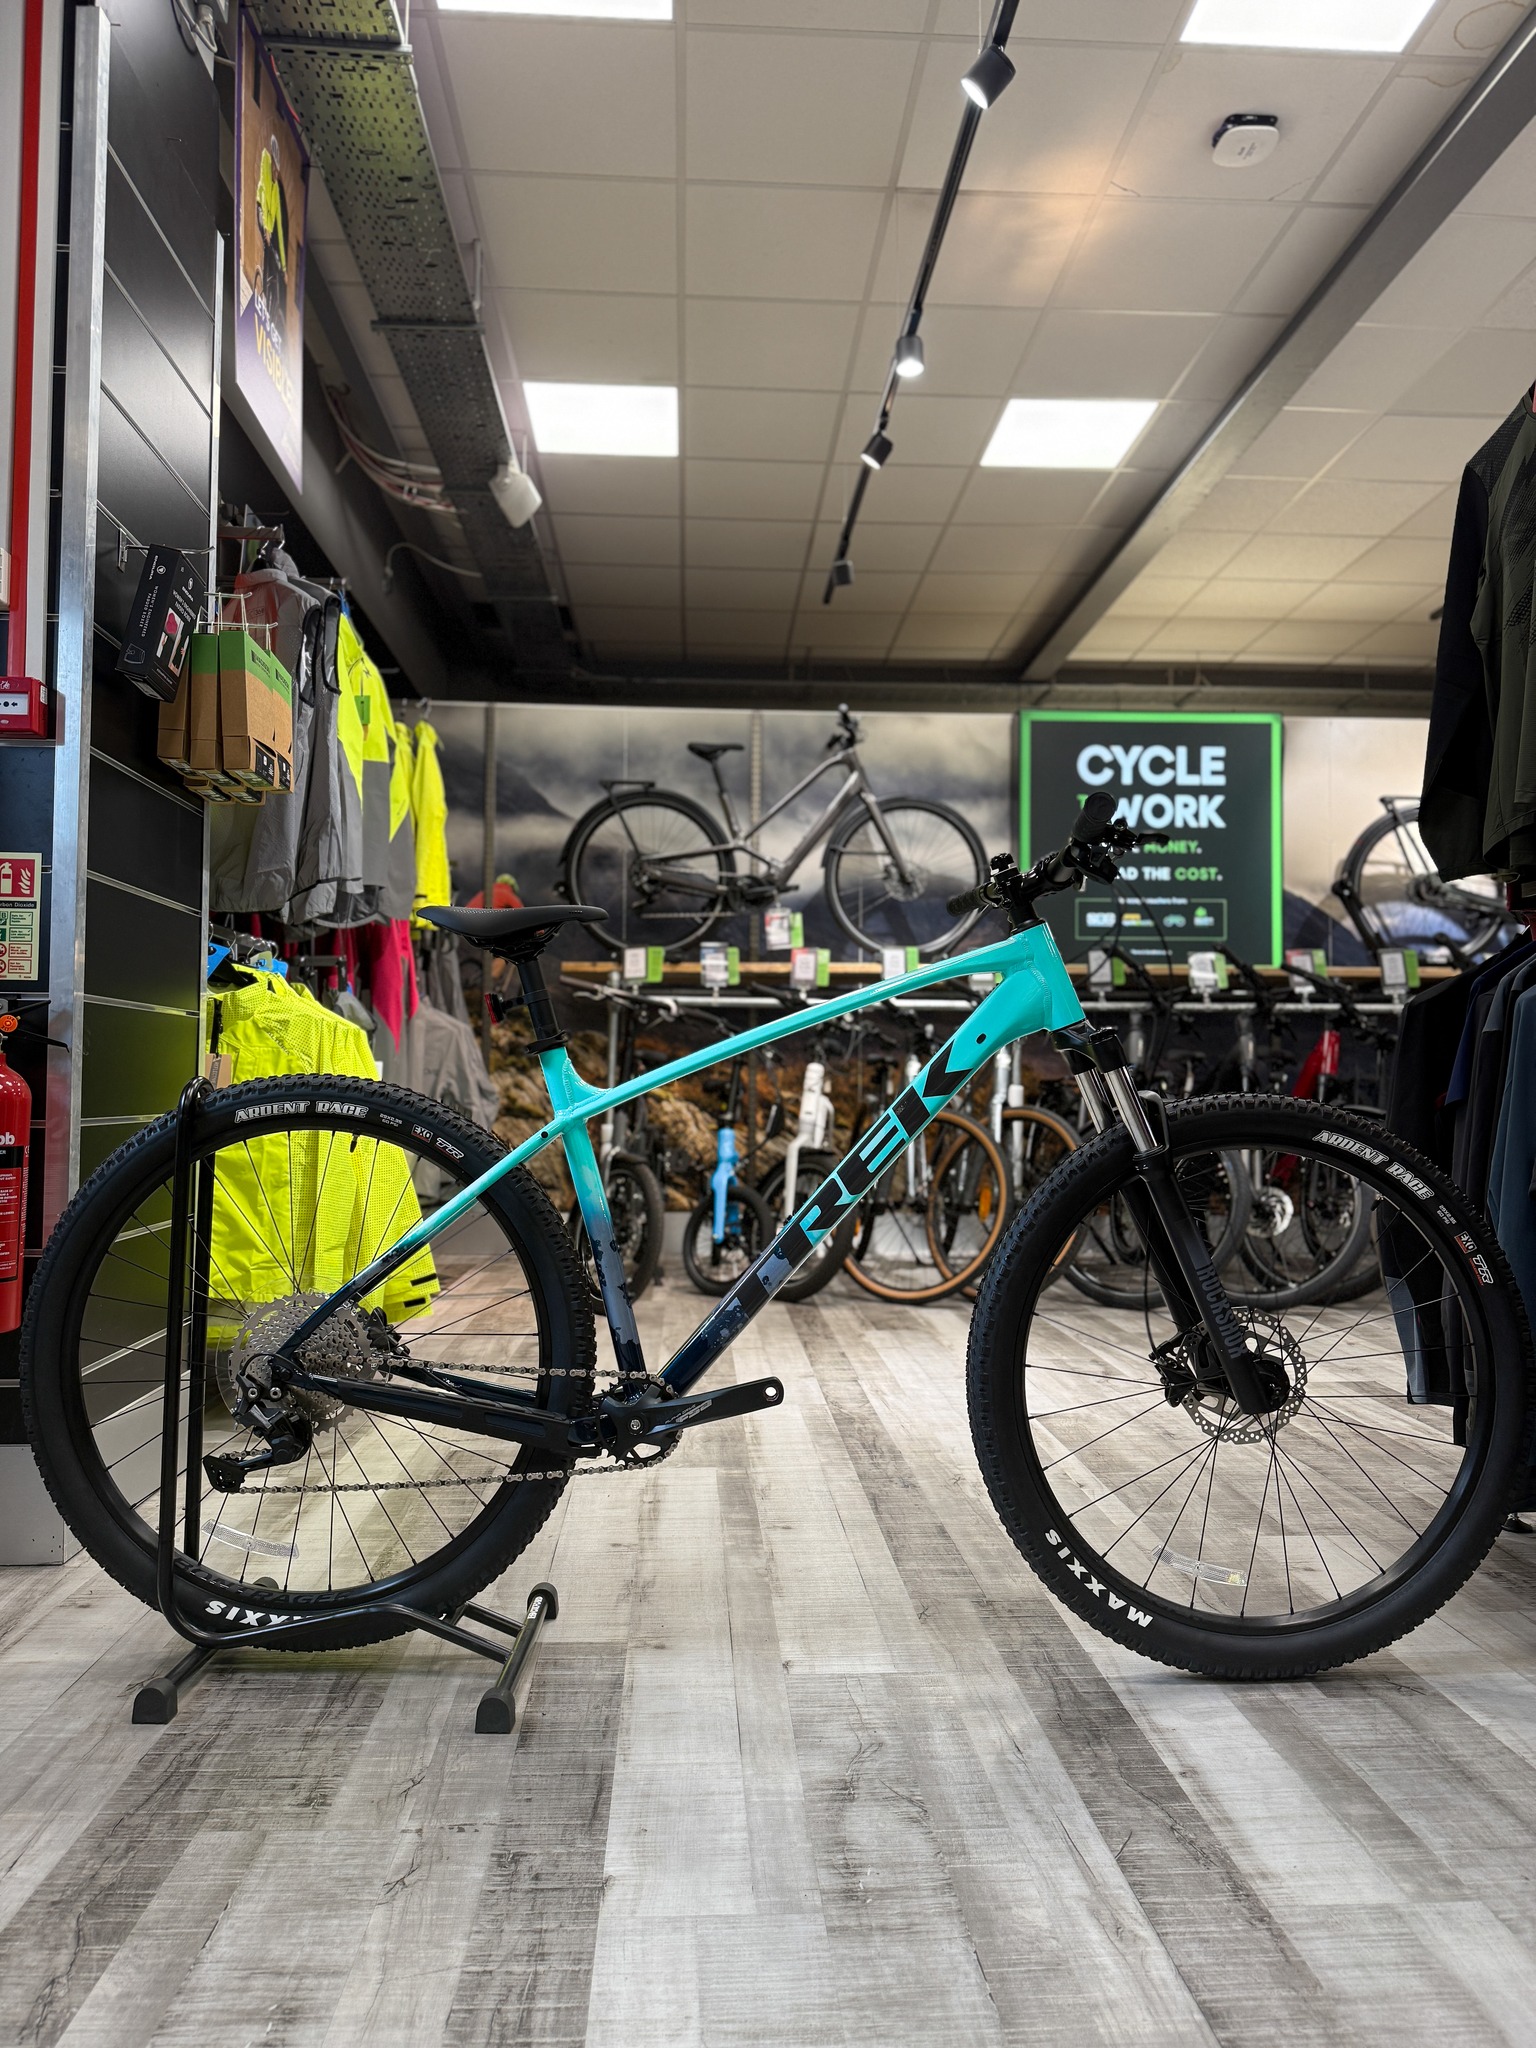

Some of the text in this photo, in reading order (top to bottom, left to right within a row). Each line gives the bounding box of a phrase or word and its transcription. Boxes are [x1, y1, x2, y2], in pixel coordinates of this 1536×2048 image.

[254, 312, 293, 403] VISIBLE
[1076, 744, 1226, 786] CYCLE
[1111, 794, 1226, 829] WORK
[1142, 866, 1171, 882] THE
[1174, 866, 1224, 882] COST.
[234, 1100, 370, 1123] ARDENT RACE
[412, 1124, 433, 1141] EXO
[714, 1038, 974, 1319] TREK
[1312, 1130, 1435, 1200] ARDENT RACE
[1458, 1231, 1477, 1253] EXO
[1472, 1254, 1494, 1285] TR
[1196, 1264, 1249, 1360] ROCKSHOX
[1045, 1529, 1154, 1628] MAXXIS
[205, 1600, 313, 1627] XXIS
